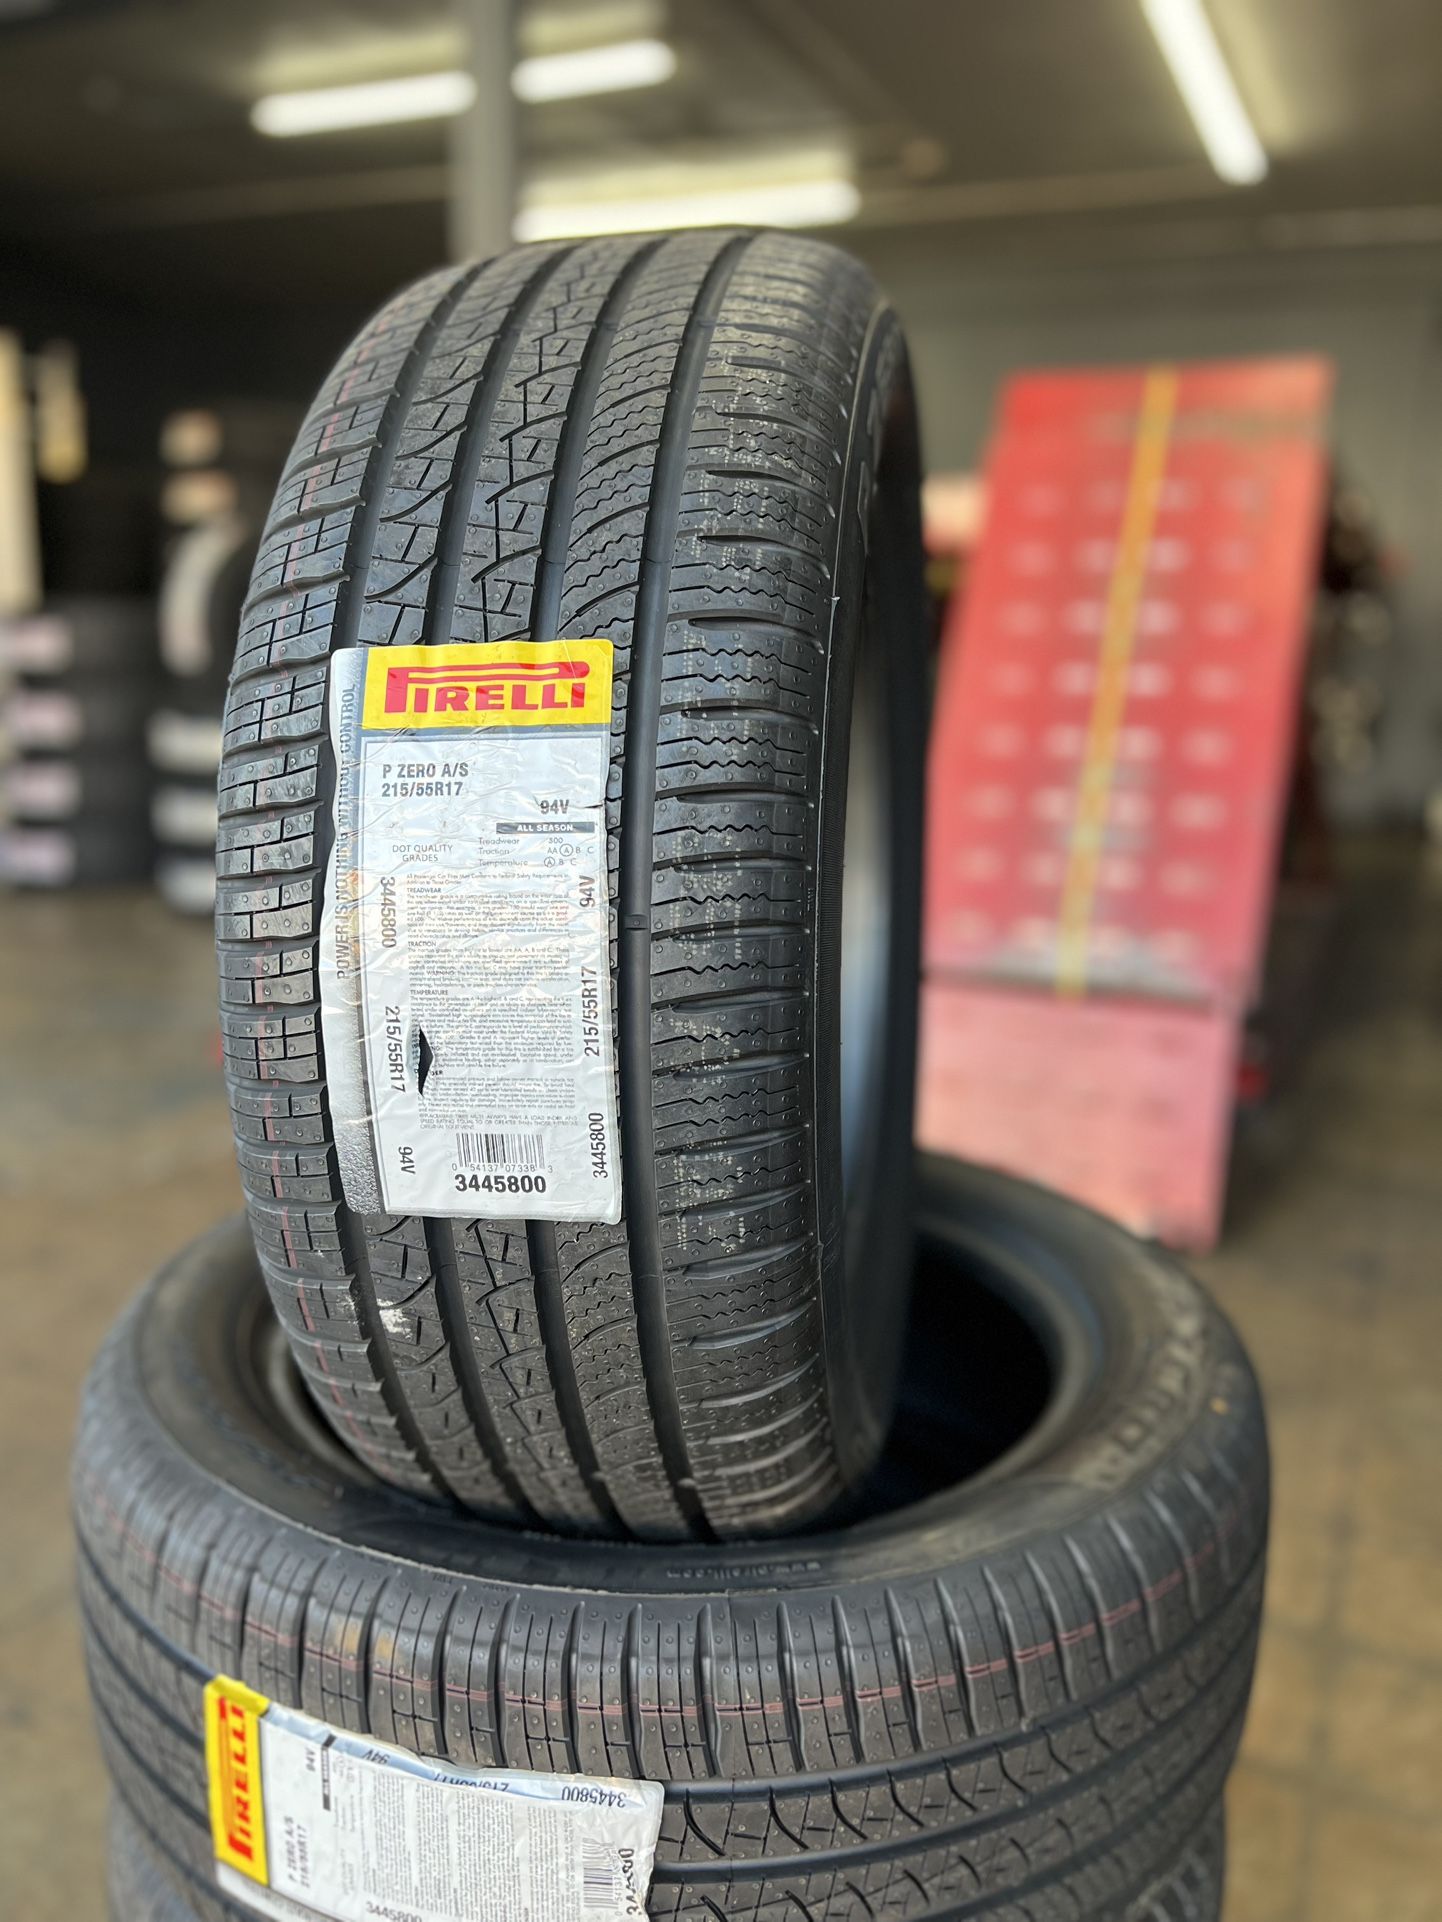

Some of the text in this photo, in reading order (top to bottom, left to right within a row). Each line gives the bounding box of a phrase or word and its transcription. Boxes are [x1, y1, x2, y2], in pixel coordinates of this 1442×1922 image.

[384, 661, 590, 713] PIRELLI
[340, 684, 355, 753] CONTROL
[382, 762, 469, 779] P ZERO A/S
[381, 781, 463, 797] 215/55R17
[540, 800, 569, 815] 94V
[517, 824, 574, 832] ALL SEASON
[414, 844, 453, 853] QUALITY
[479, 837, 519, 845] Treadwear
[335, 832, 351, 900] NOTHING
[402, 854, 439, 862] GRADES
[579, 875, 595, 908] 94V
[335, 904, 349, 923] IS
[380, 876, 397, 948] 3445800
[335, 925, 350, 979] POWER
[581, 967, 600, 1057] 215/55R17
[385, 1005, 406, 1093] 215/55R17
[588, 1112, 608, 1179] 3445800
[398, 1146, 416, 1175] 94V
[452, 1163, 458, 1171] 0
[470, 1164, 499, 1172] 54137
[547, 1165, 553, 1173] 3
[454, 1173, 547, 1194] 3445800
[361, 1749, 390, 1765] 94V
[218, 1696, 254, 1862] PIRELLI
[561, 1785, 627, 1809] 3445800
